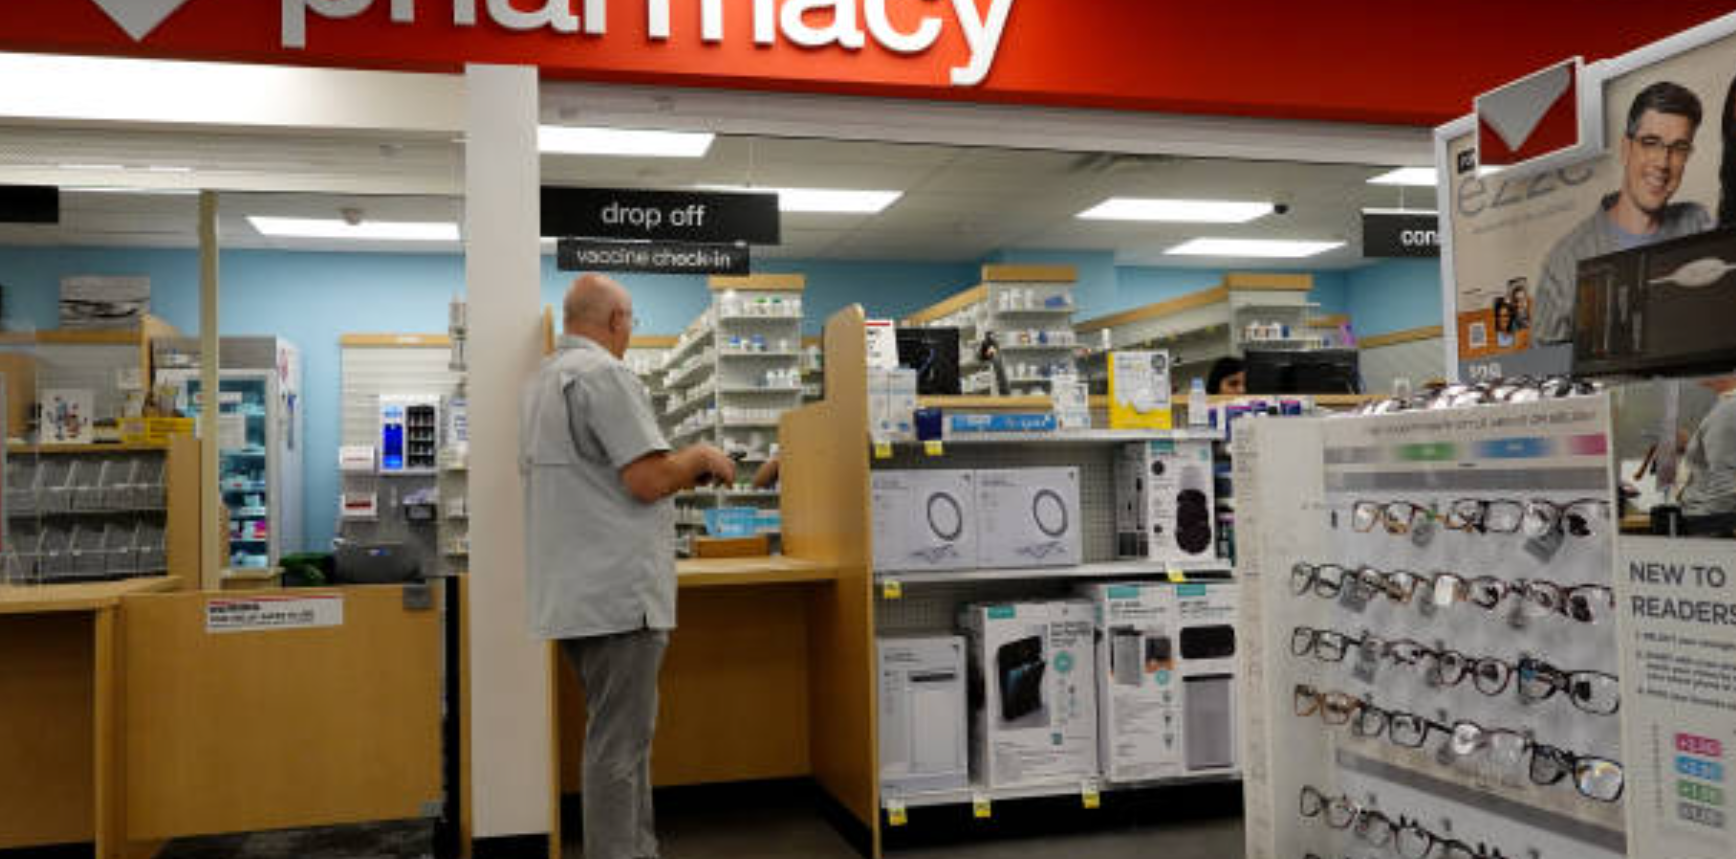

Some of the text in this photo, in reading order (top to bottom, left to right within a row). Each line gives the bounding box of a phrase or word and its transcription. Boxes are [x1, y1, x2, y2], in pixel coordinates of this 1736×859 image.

[281, 0, 1014, 86] pmacy
[601, 201, 706, 230] drop off
[1401, 229, 1440, 247] con
[576, 249, 731, 268] vaccine check-in
[1629, 561, 1726, 588] NEW TO
